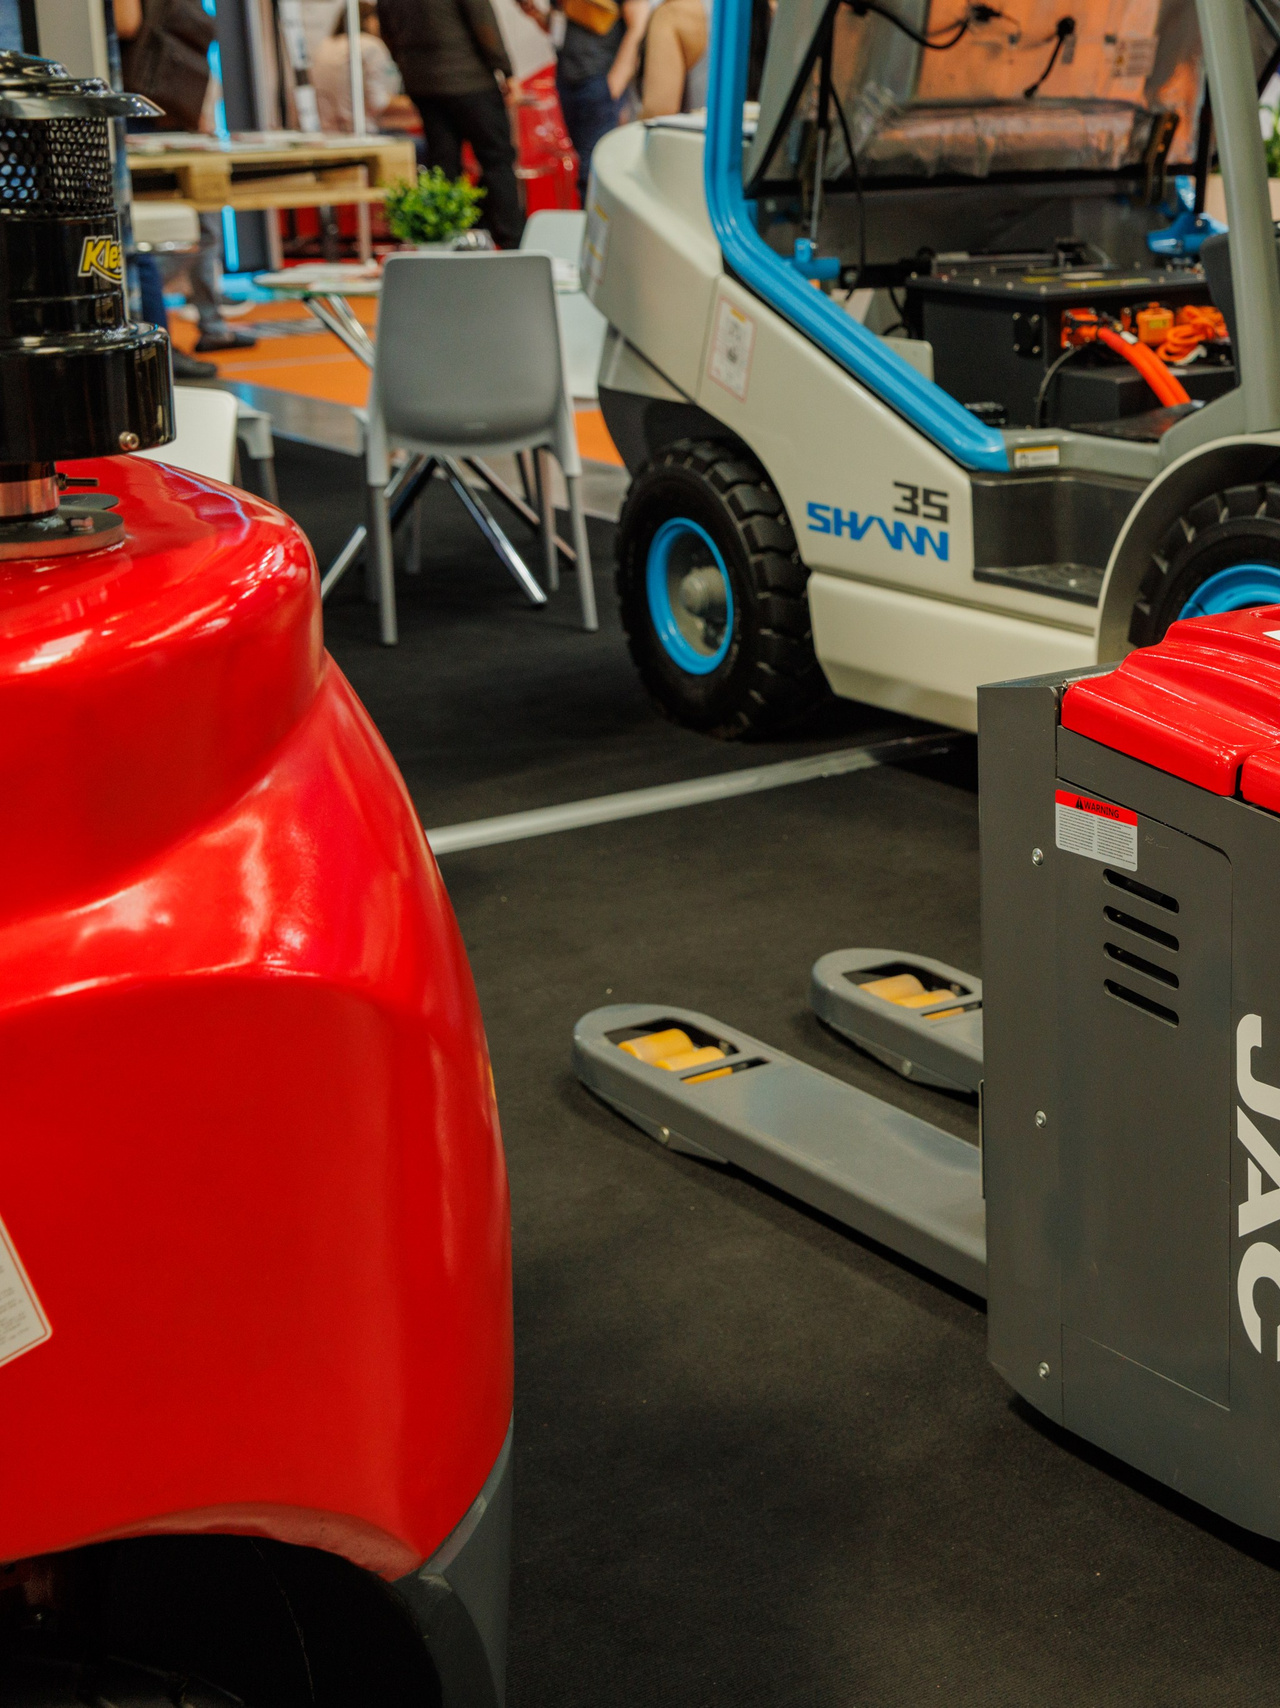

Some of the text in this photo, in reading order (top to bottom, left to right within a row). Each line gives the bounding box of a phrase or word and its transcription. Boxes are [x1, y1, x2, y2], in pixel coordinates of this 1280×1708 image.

[80, 236, 123, 281] Kle
[893, 478, 949, 524] 35
[807, 501, 949, 562] SHANN
[1084, 800, 1120, 819] WARNING
